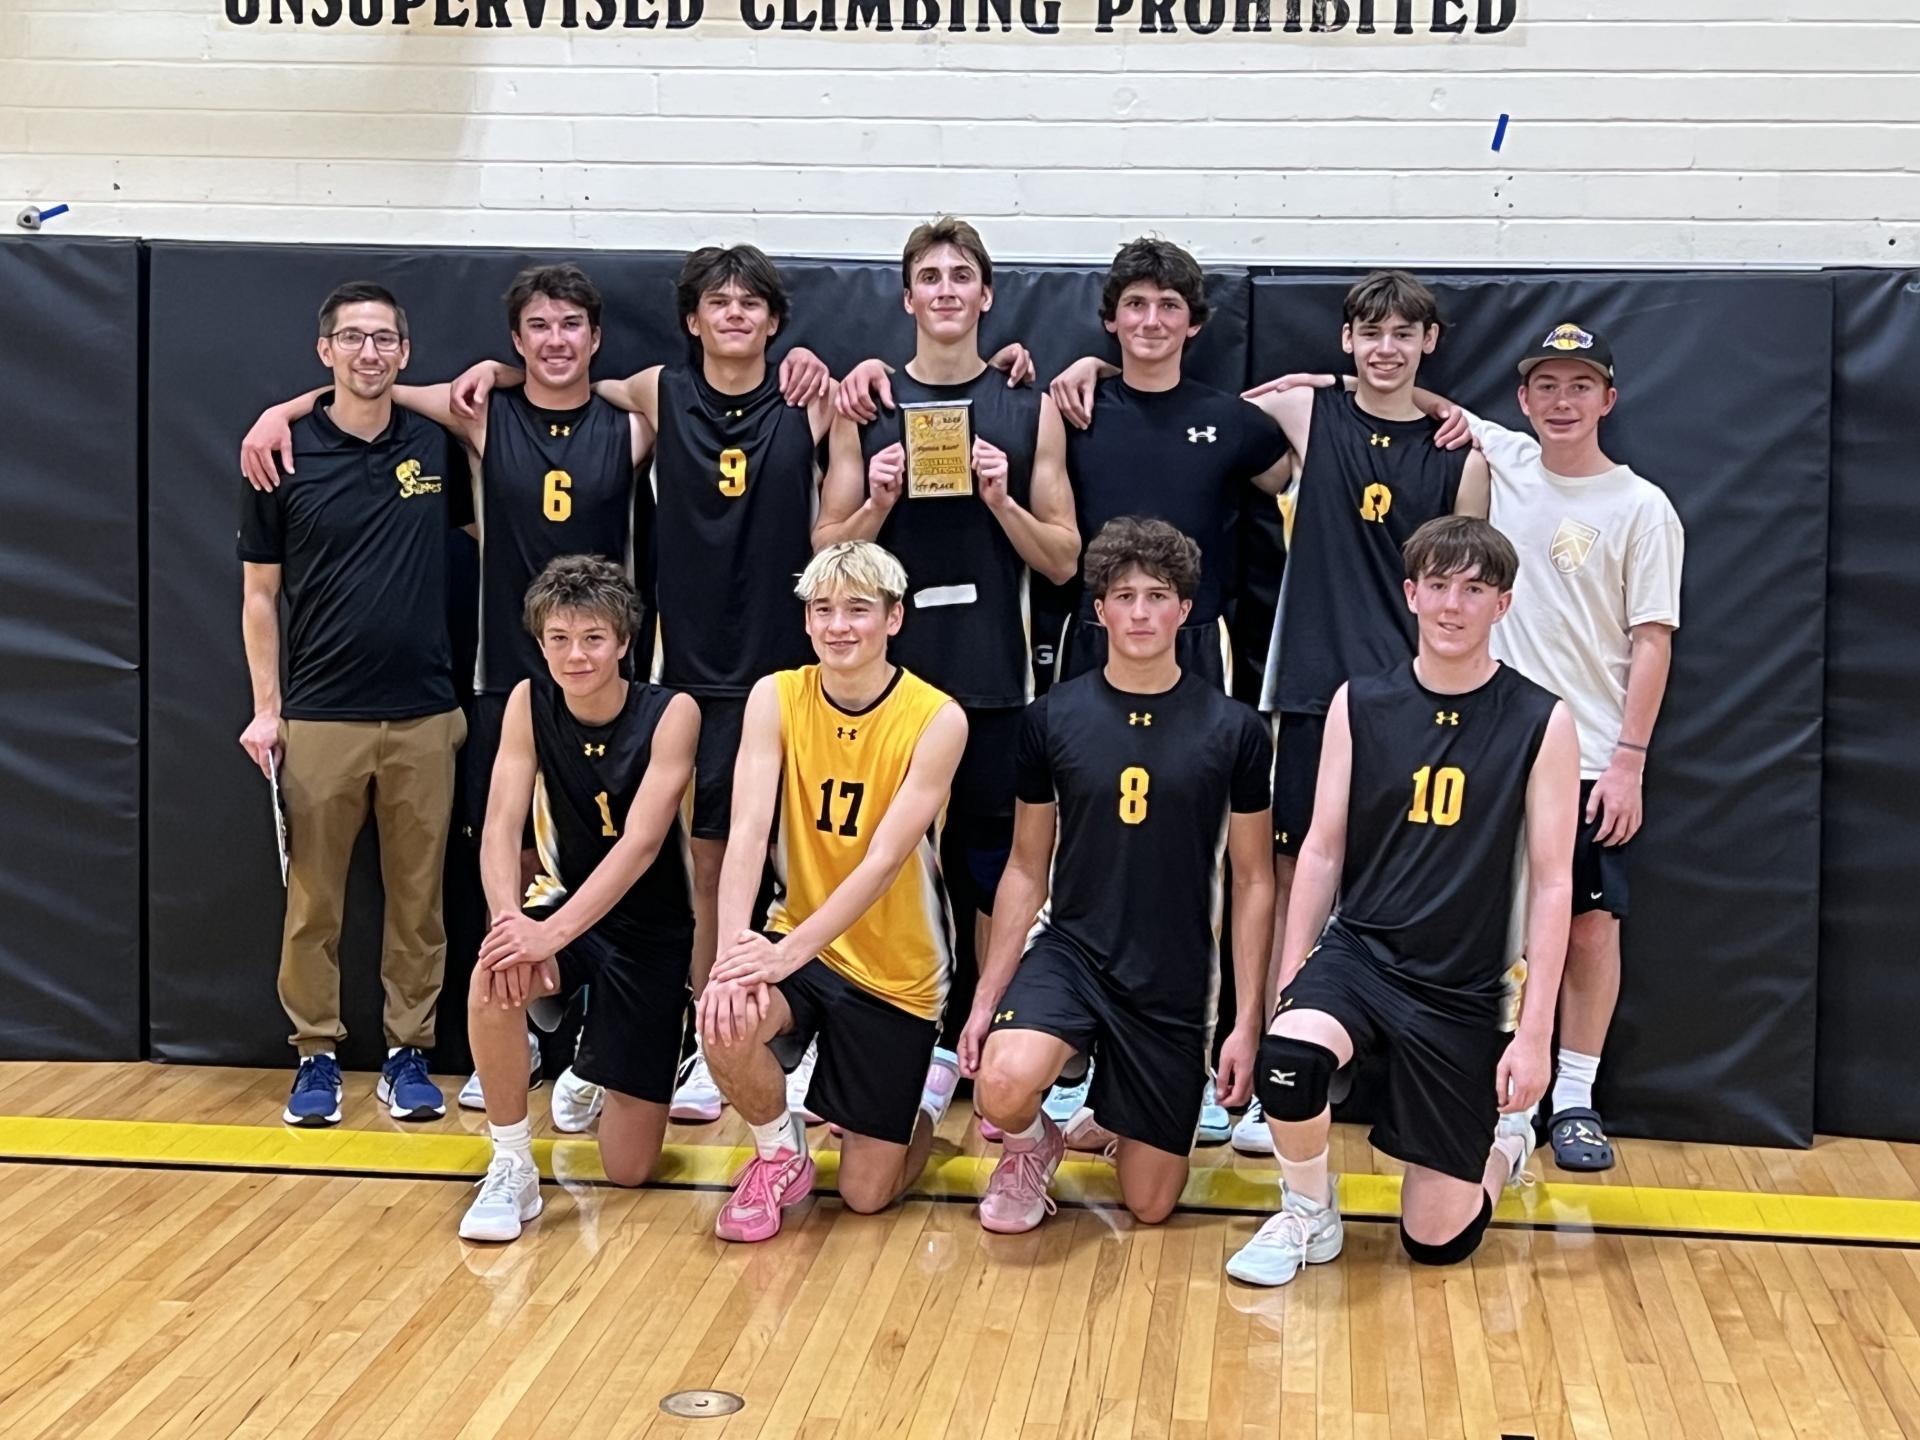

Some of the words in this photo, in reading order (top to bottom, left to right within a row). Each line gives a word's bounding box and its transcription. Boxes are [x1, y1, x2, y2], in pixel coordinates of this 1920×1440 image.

[740, 0, 1061, 34] CLIMBING
[1094, 0, 1517, 34] PROHIBITED
[543, 470, 572, 522] 6
[718, 448, 747, 497] 9
[594, 791, 618, 837] 1
[816, 778, 864, 837] 17
[1118, 766, 1150, 825] 8
[1407, 765, 1466, 826] 10
